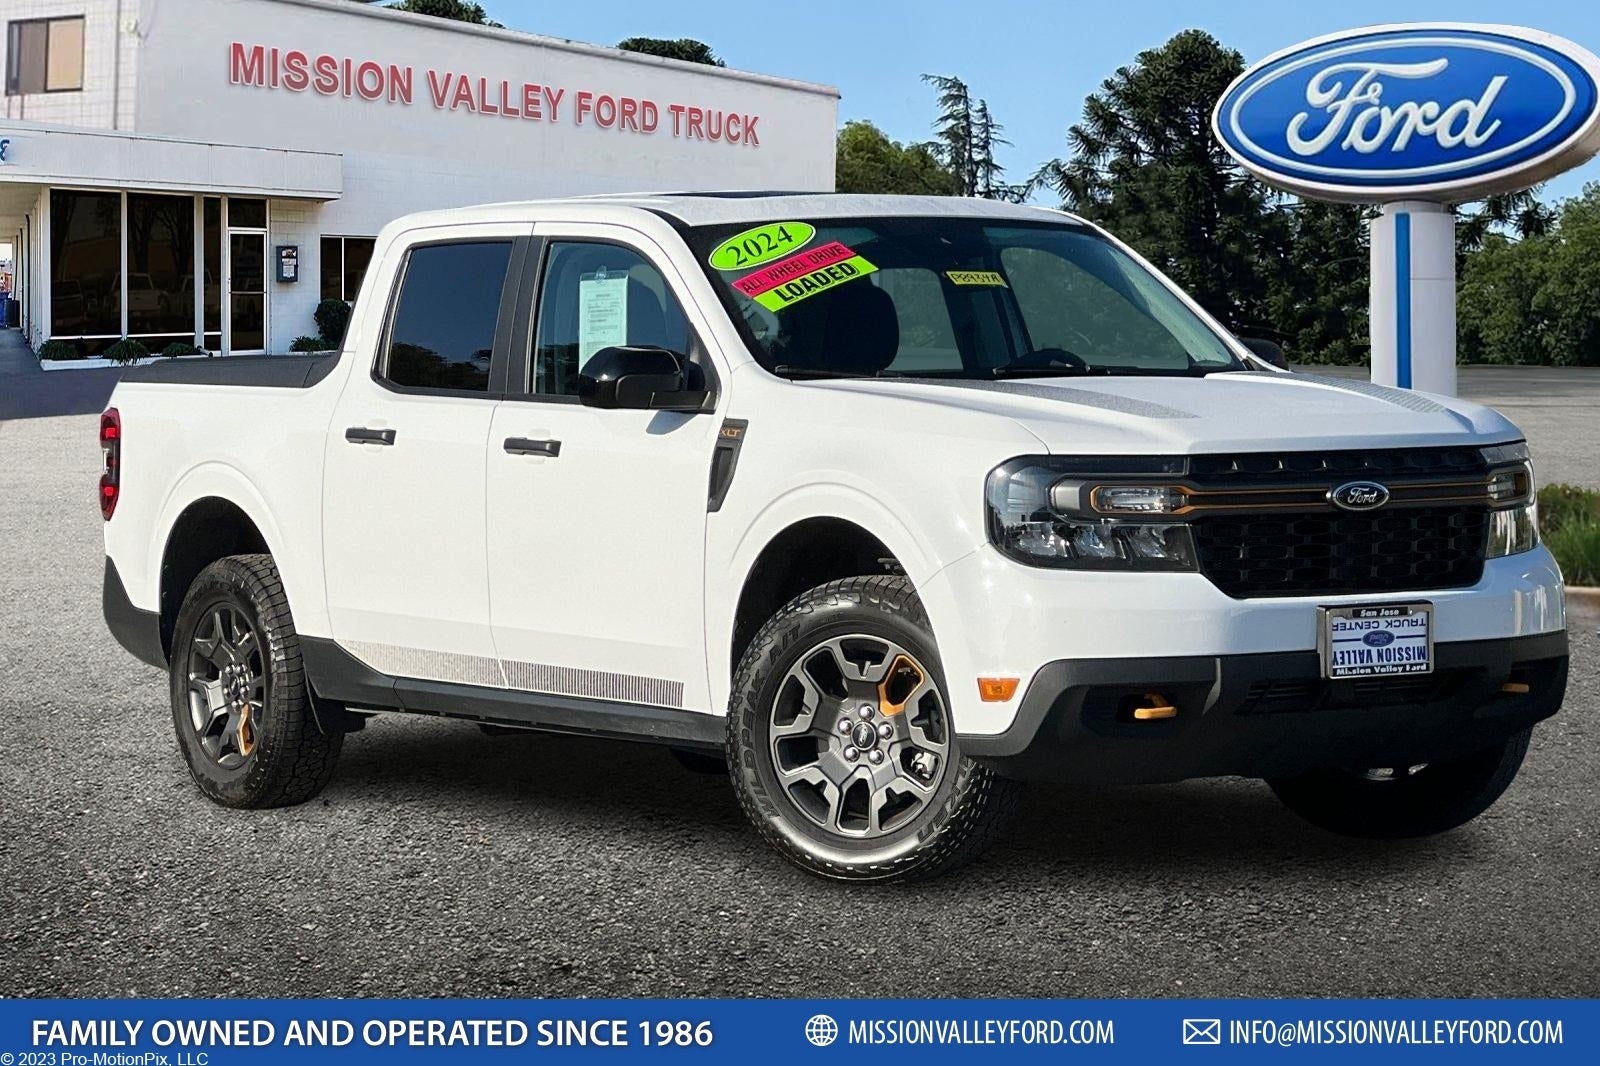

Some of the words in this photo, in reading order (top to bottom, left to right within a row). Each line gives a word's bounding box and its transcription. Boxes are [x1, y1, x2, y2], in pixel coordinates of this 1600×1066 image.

[230, 42, 414, 104] MISSION
[427, 70, 565, 121] VALLEY
[576, 91, 658, 133] FORD
[669, 104, 760, 146] TRUCK
[1286, 58, 1509, 156] Ford
[726, 225, 793, 266] 2024
[742, 278, 766, 293] ALL
[767, 262, 807, 281] WHEEL
[810, 244, 845, 264] DRIVE
[773, 262, 860, 302] LOADED
[720, 428, 742, 438] XLT
[1347, 487, 1378, 503] Ford
[1360, 609, 1377, 617] San
[1380, 608, 1400, 616] Jose
[1332, 620, 1380, 631] CENTER
[1385, 618, 1426, 629] TRUCK
[1332, 649, 1373, 666] VALLEY
[1377, 646, 1426, 663] MISSION
[1374, 665, 1404, 674] Valley
